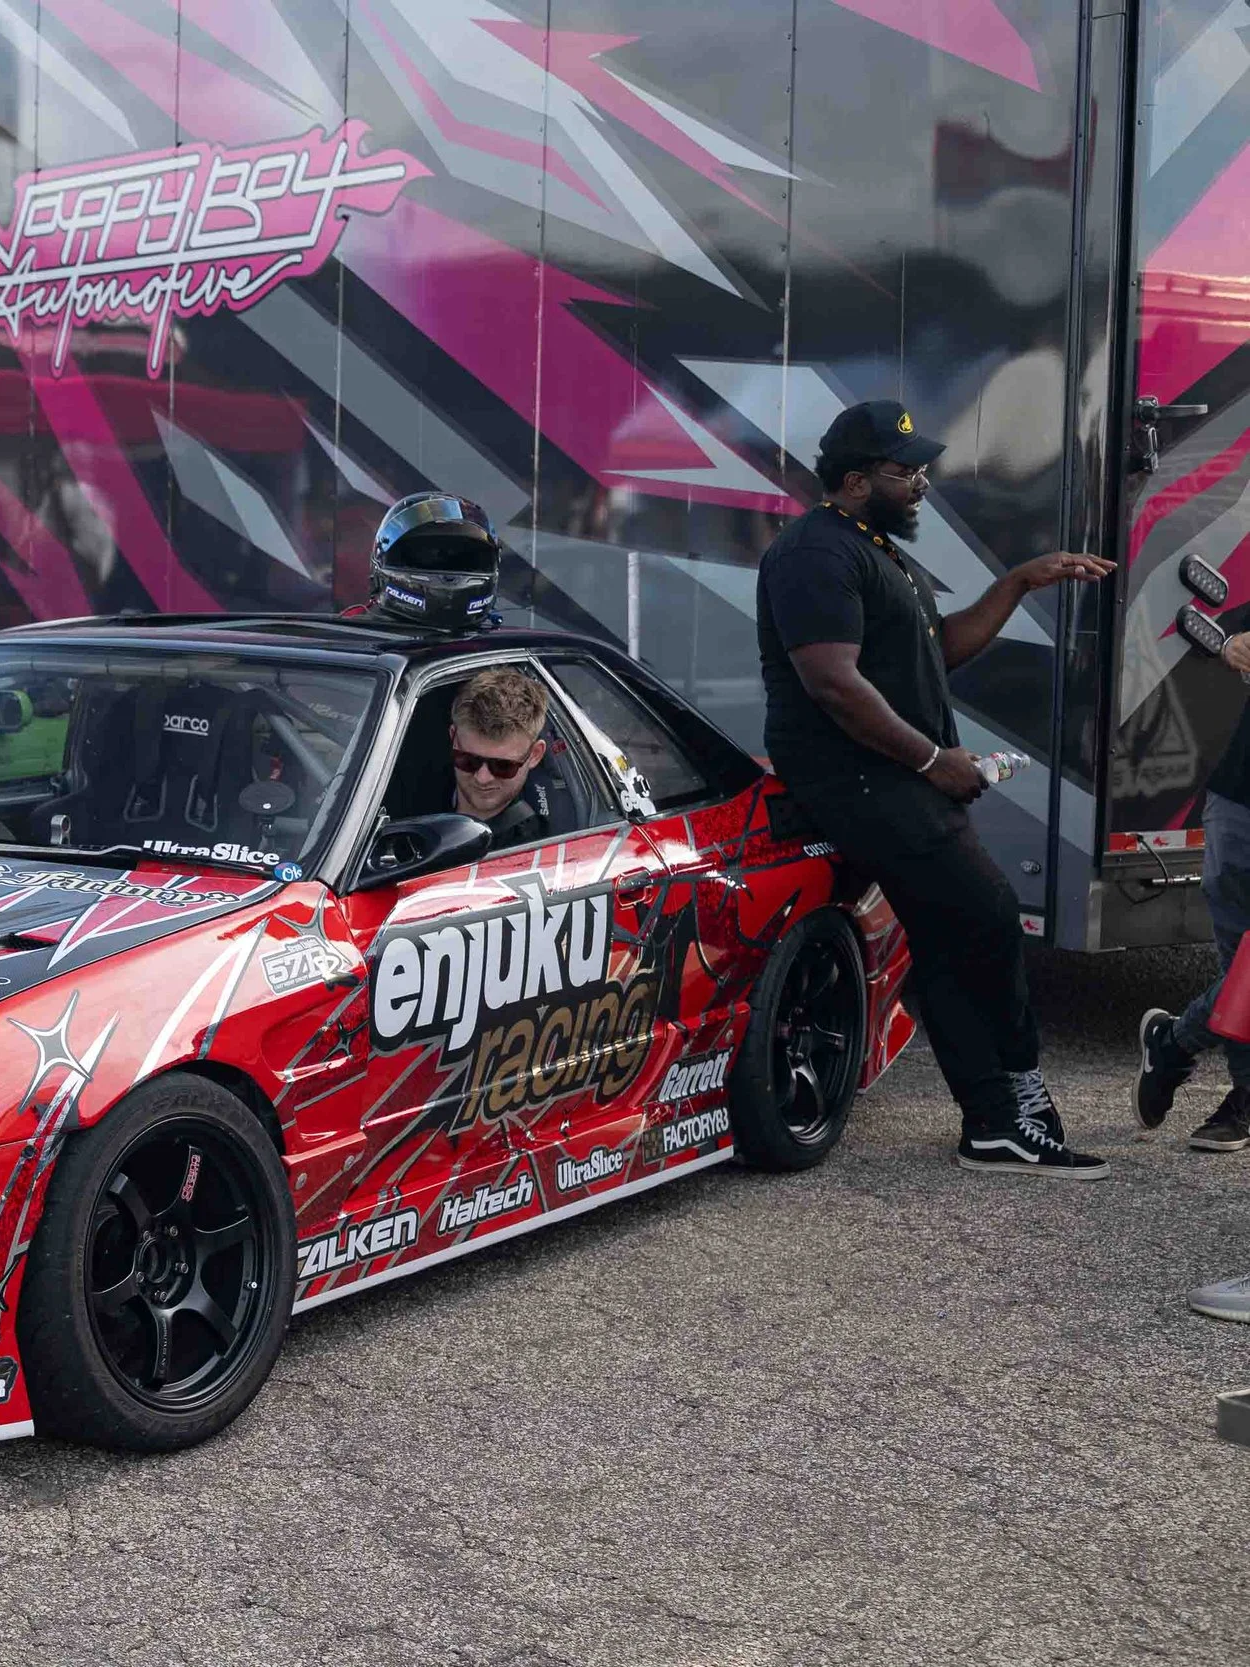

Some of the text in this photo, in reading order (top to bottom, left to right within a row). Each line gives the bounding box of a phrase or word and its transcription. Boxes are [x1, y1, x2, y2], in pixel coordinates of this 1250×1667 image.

[385, 585, 423, 607] FALKEN
[374, 883, 608, 1051] enjuku
[462, 981, 658, 1120] racing
[658, 1051, 730, 1102] Garrett
[558, 1150, 623, 1190] UltraSlice
[439, 1176, 535, 1231] Haltech
